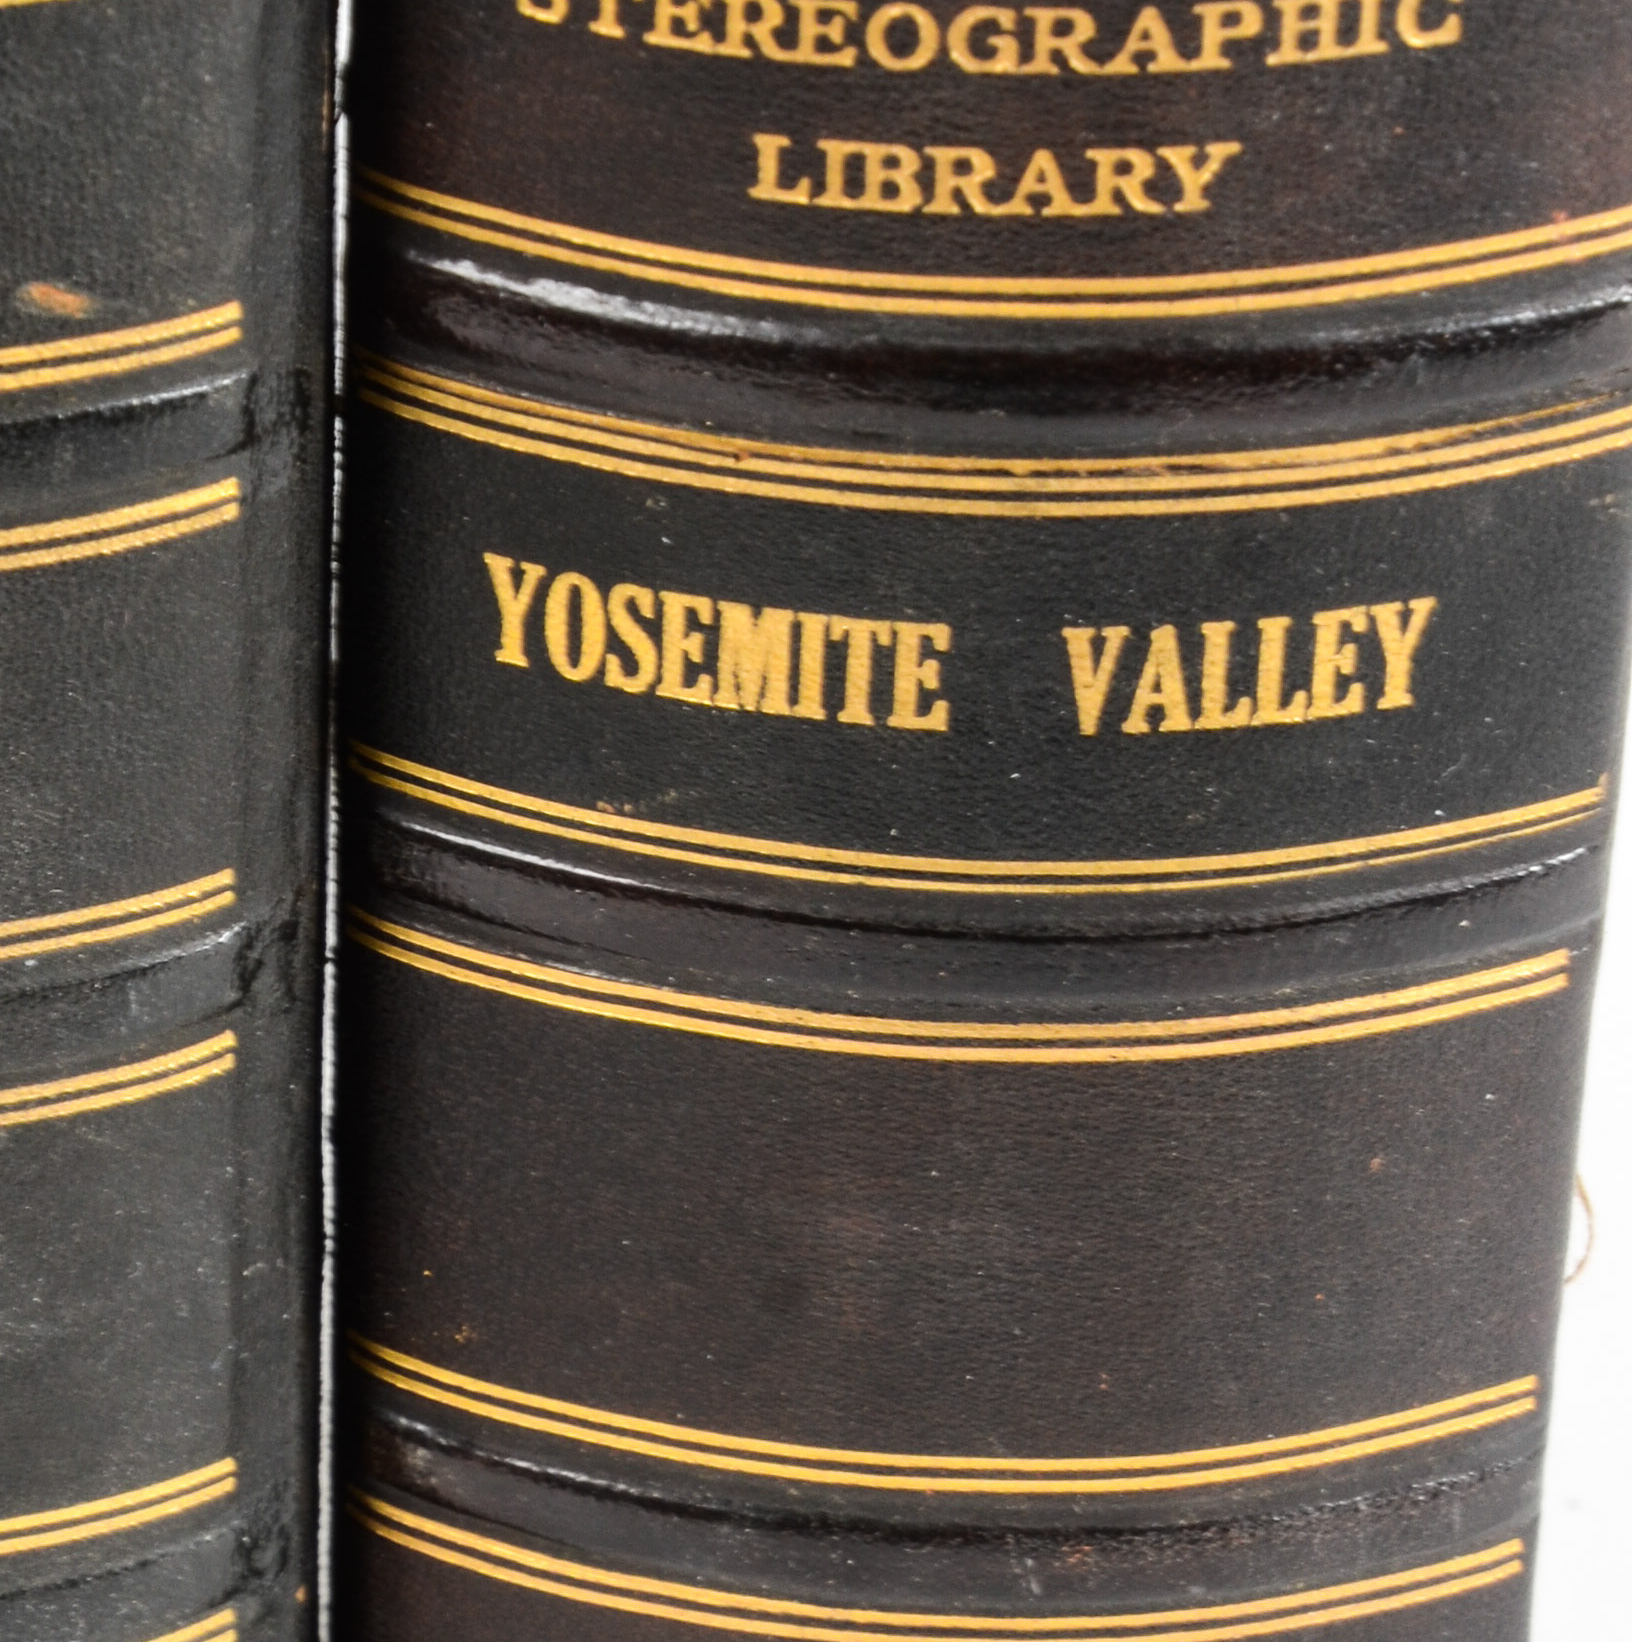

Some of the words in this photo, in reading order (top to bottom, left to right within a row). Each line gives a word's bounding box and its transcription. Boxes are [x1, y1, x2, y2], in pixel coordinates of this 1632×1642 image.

[747, 133, 1243, 217] LIBRARY
[483, 552, 952, 731] YOSEMITE
[1061, 597, 1438, 735] VALLEY
